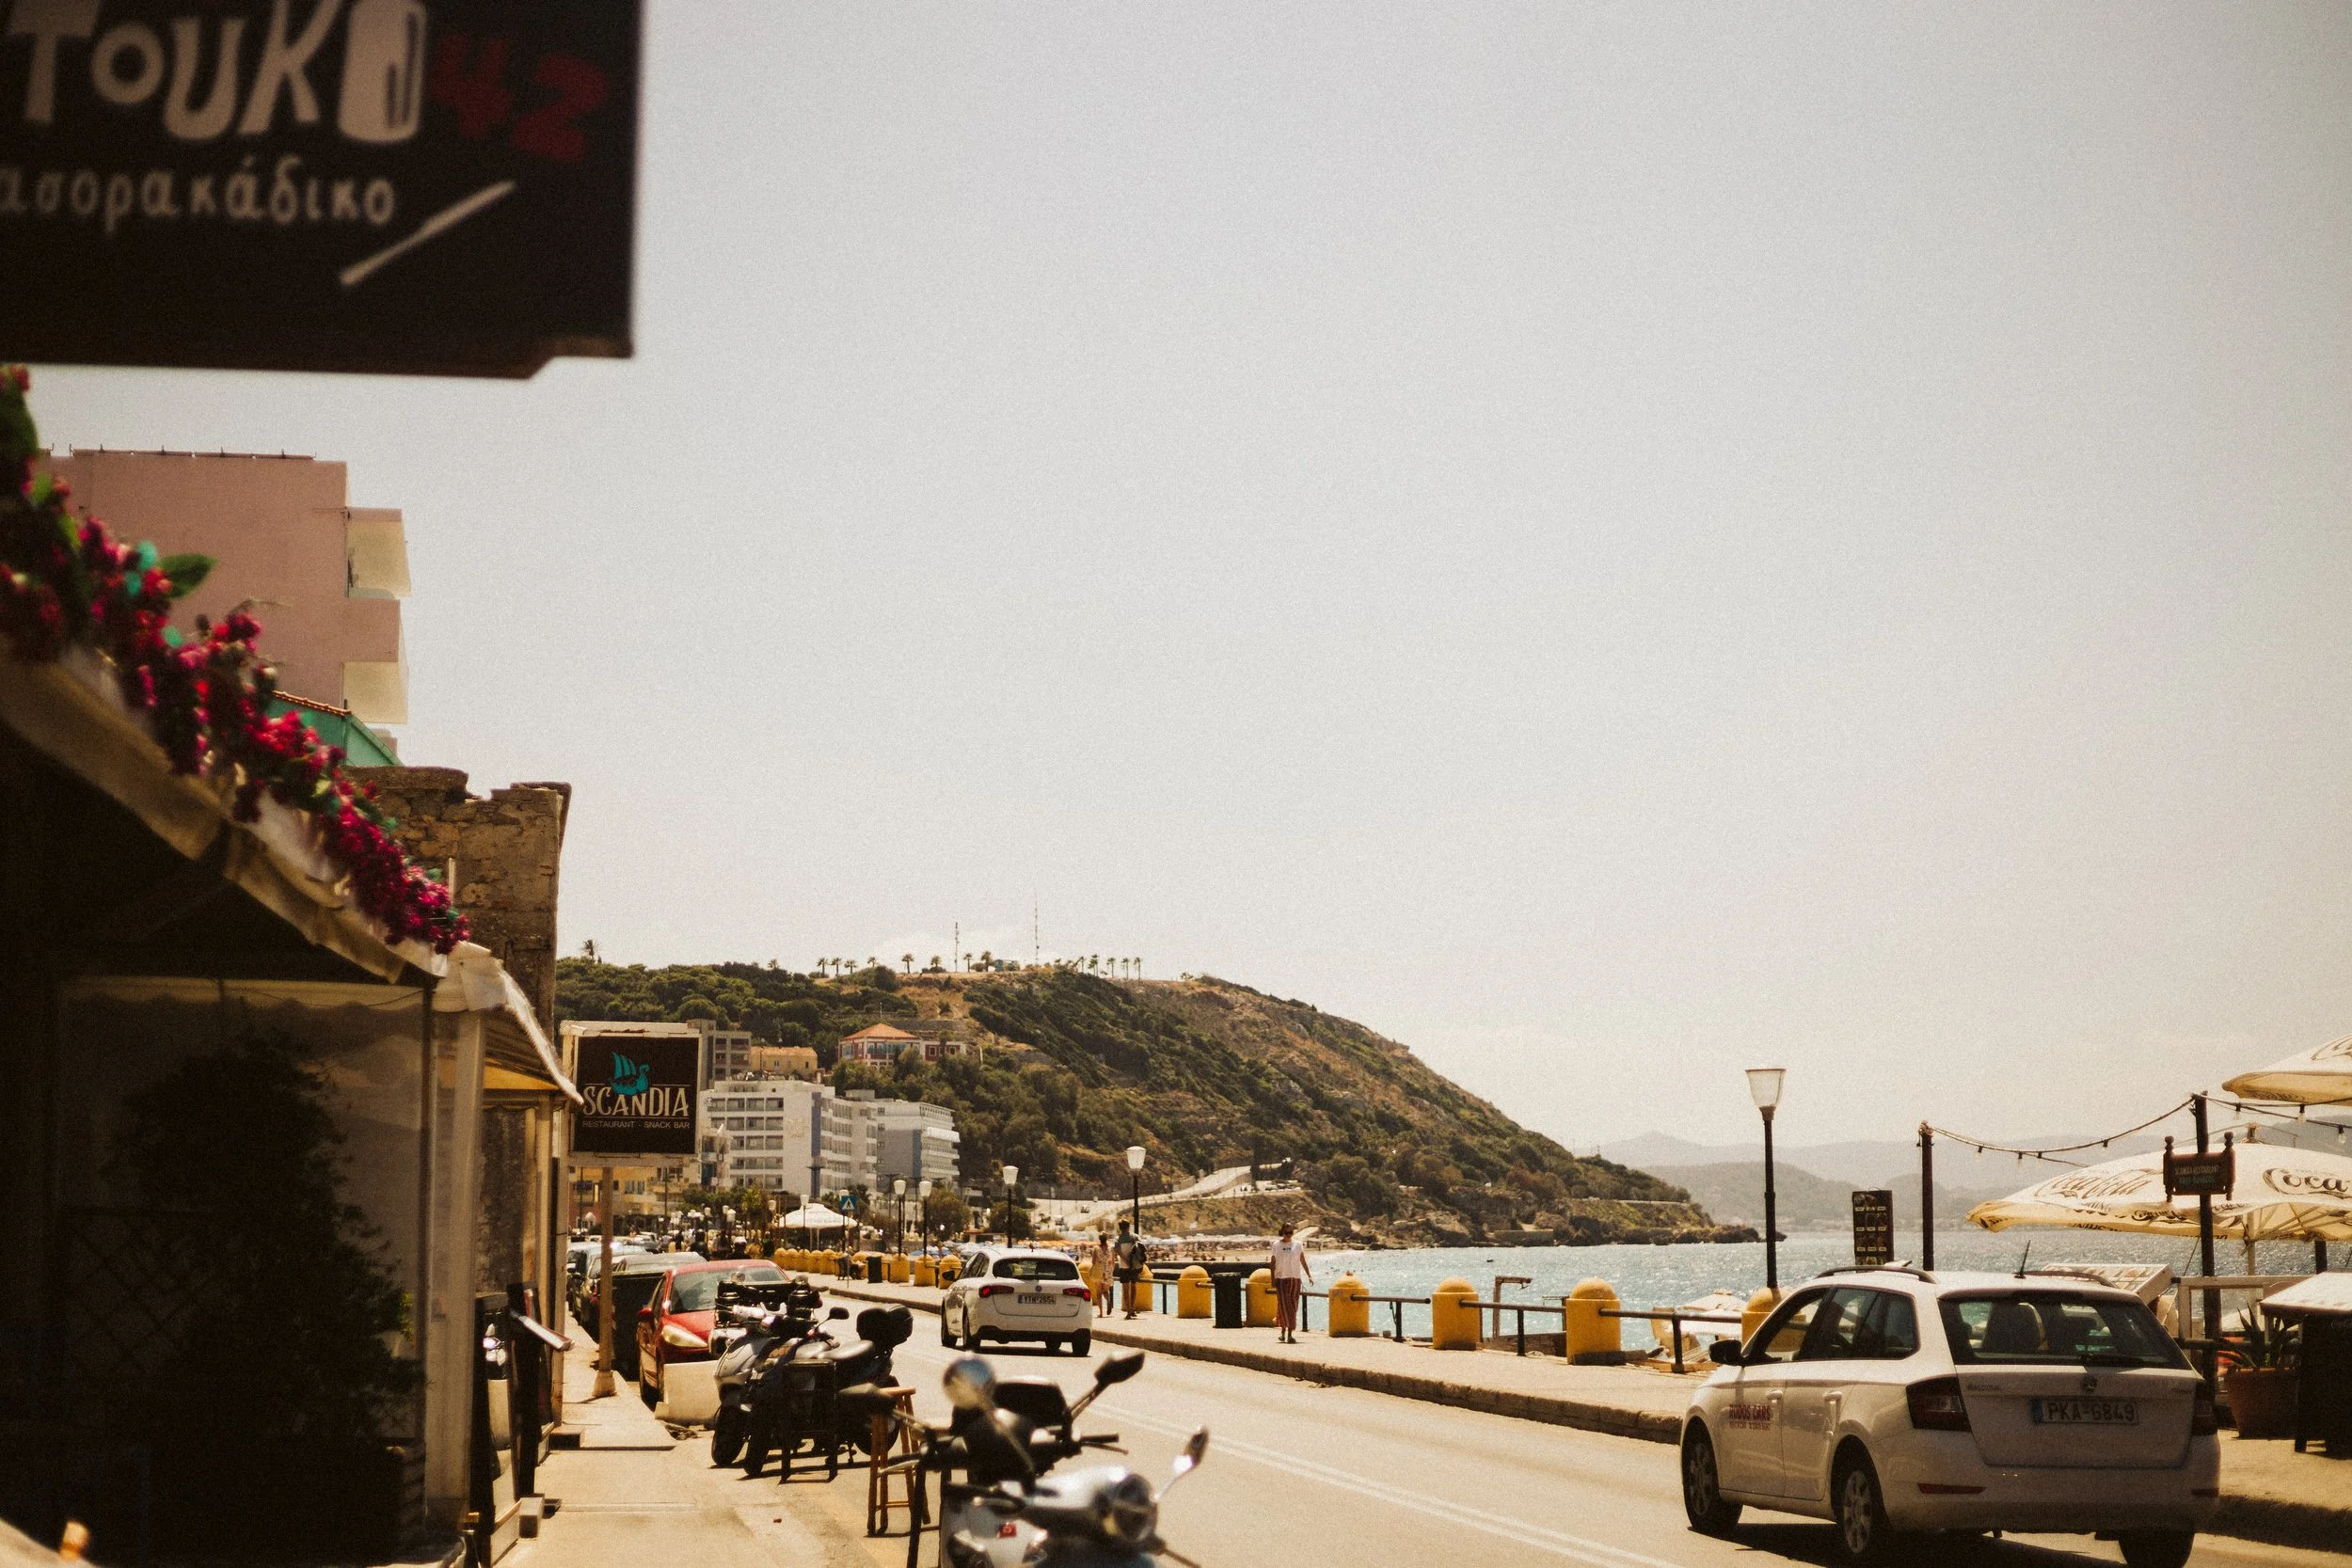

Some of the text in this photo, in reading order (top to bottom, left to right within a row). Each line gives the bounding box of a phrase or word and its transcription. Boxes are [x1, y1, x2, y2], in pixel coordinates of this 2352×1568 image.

[432, 32, 612, 162] 42
[582, 1085, 690, 1117] SCANDIA
[582, 1120, 636, 1129] RESTAURANT
[644, 1120, 671, 1129] SNACK
[674, 1120, 691, 1129] BAR
